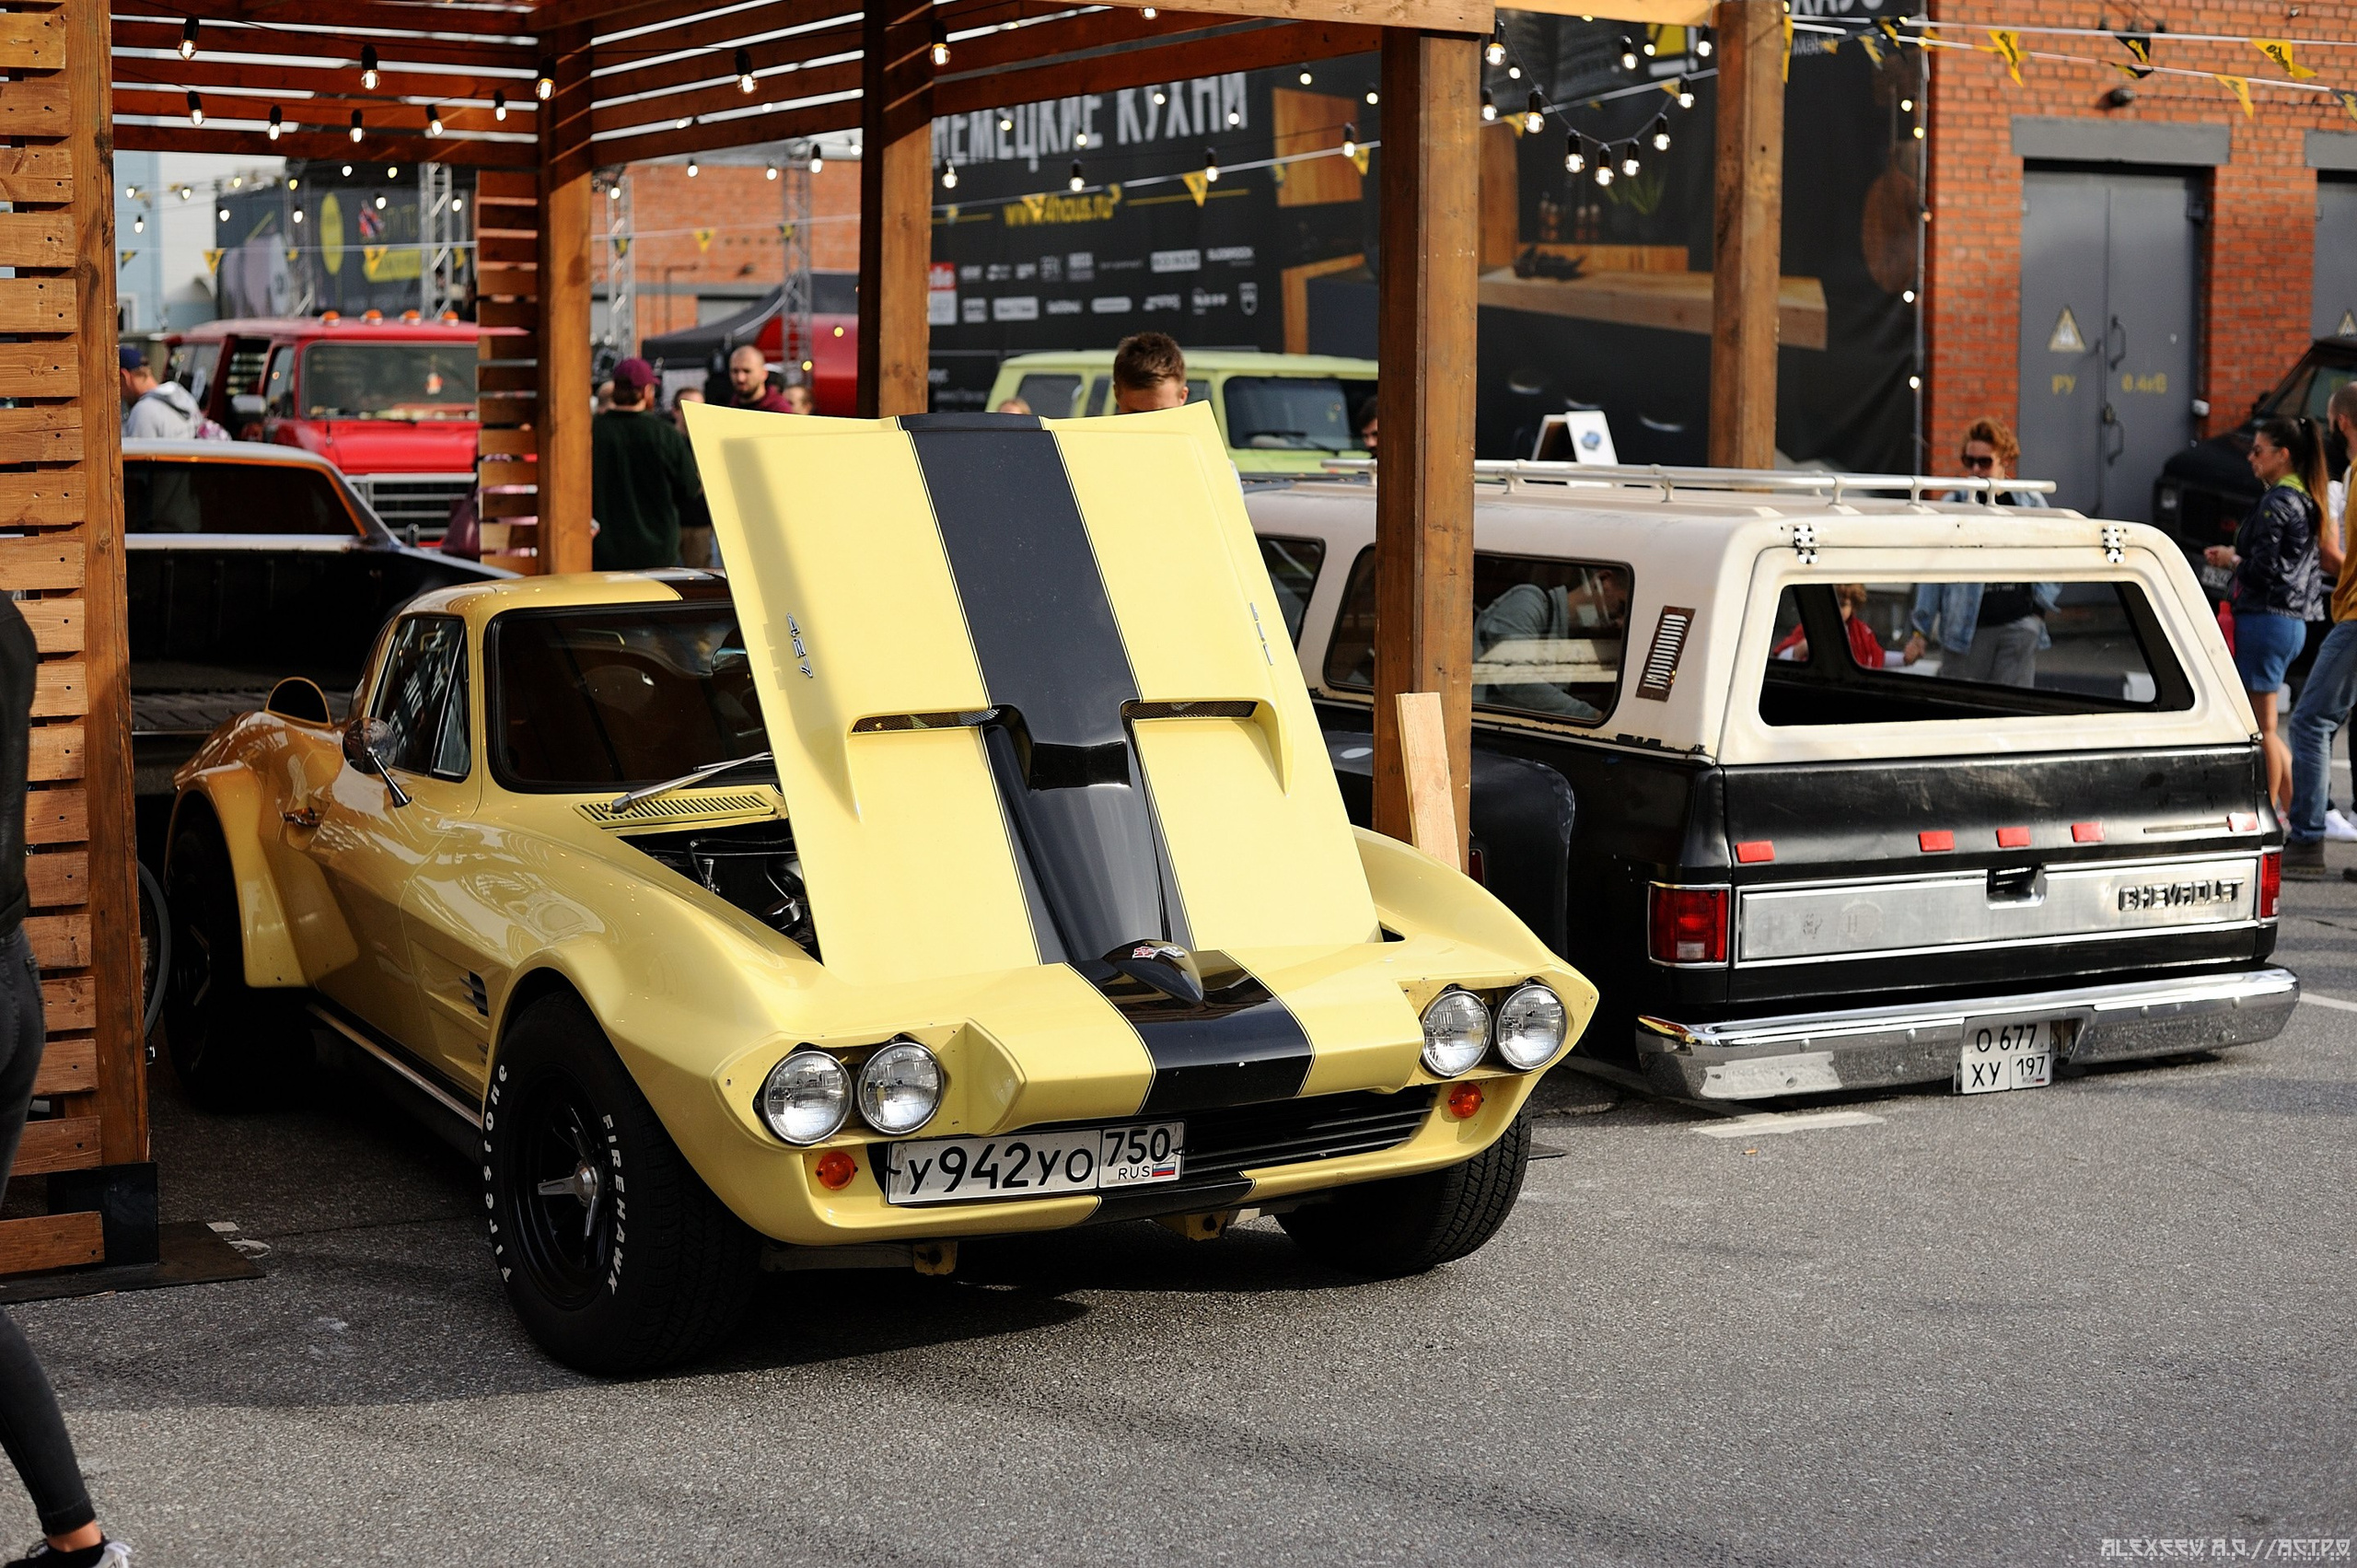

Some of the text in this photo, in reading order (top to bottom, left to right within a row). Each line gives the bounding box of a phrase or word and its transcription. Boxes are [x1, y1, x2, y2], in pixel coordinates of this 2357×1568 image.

[1116, 72, 1249, 145] КУХНИ
[2119, 877, 2245, 912] CHEVROLET
[1999, 1024, 2038, 1051] 677
[2016, 1056, 2046, 1076] 197
[1105, 1128, 1171, 1167] 750
[1117, 1166, 1150, 1180] RUS
[602, 1114, 627, 1295] FIREHAWK
